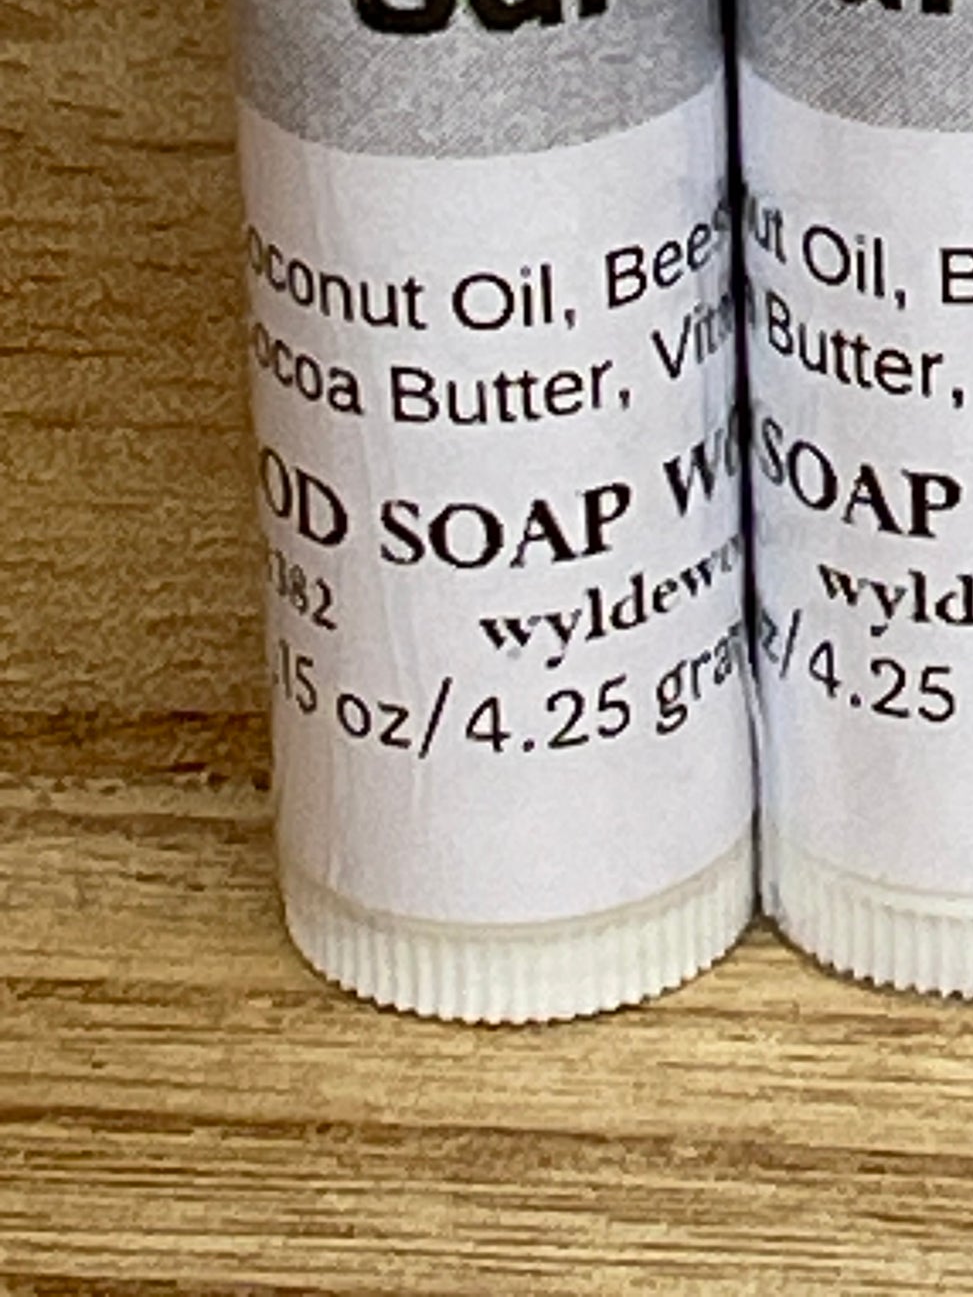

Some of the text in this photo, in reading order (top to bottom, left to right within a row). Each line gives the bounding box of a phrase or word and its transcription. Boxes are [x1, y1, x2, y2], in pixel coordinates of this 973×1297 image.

[452, 262, 578, 331] Oil,
[802, 224, 907, 310] Oil,
[765, 289, 965, 408] Butter,
[390, 359, 632, 426] Butter,
[760, 415, 962, 539] SOAP
[379, 481, 633, 570] SOAP
